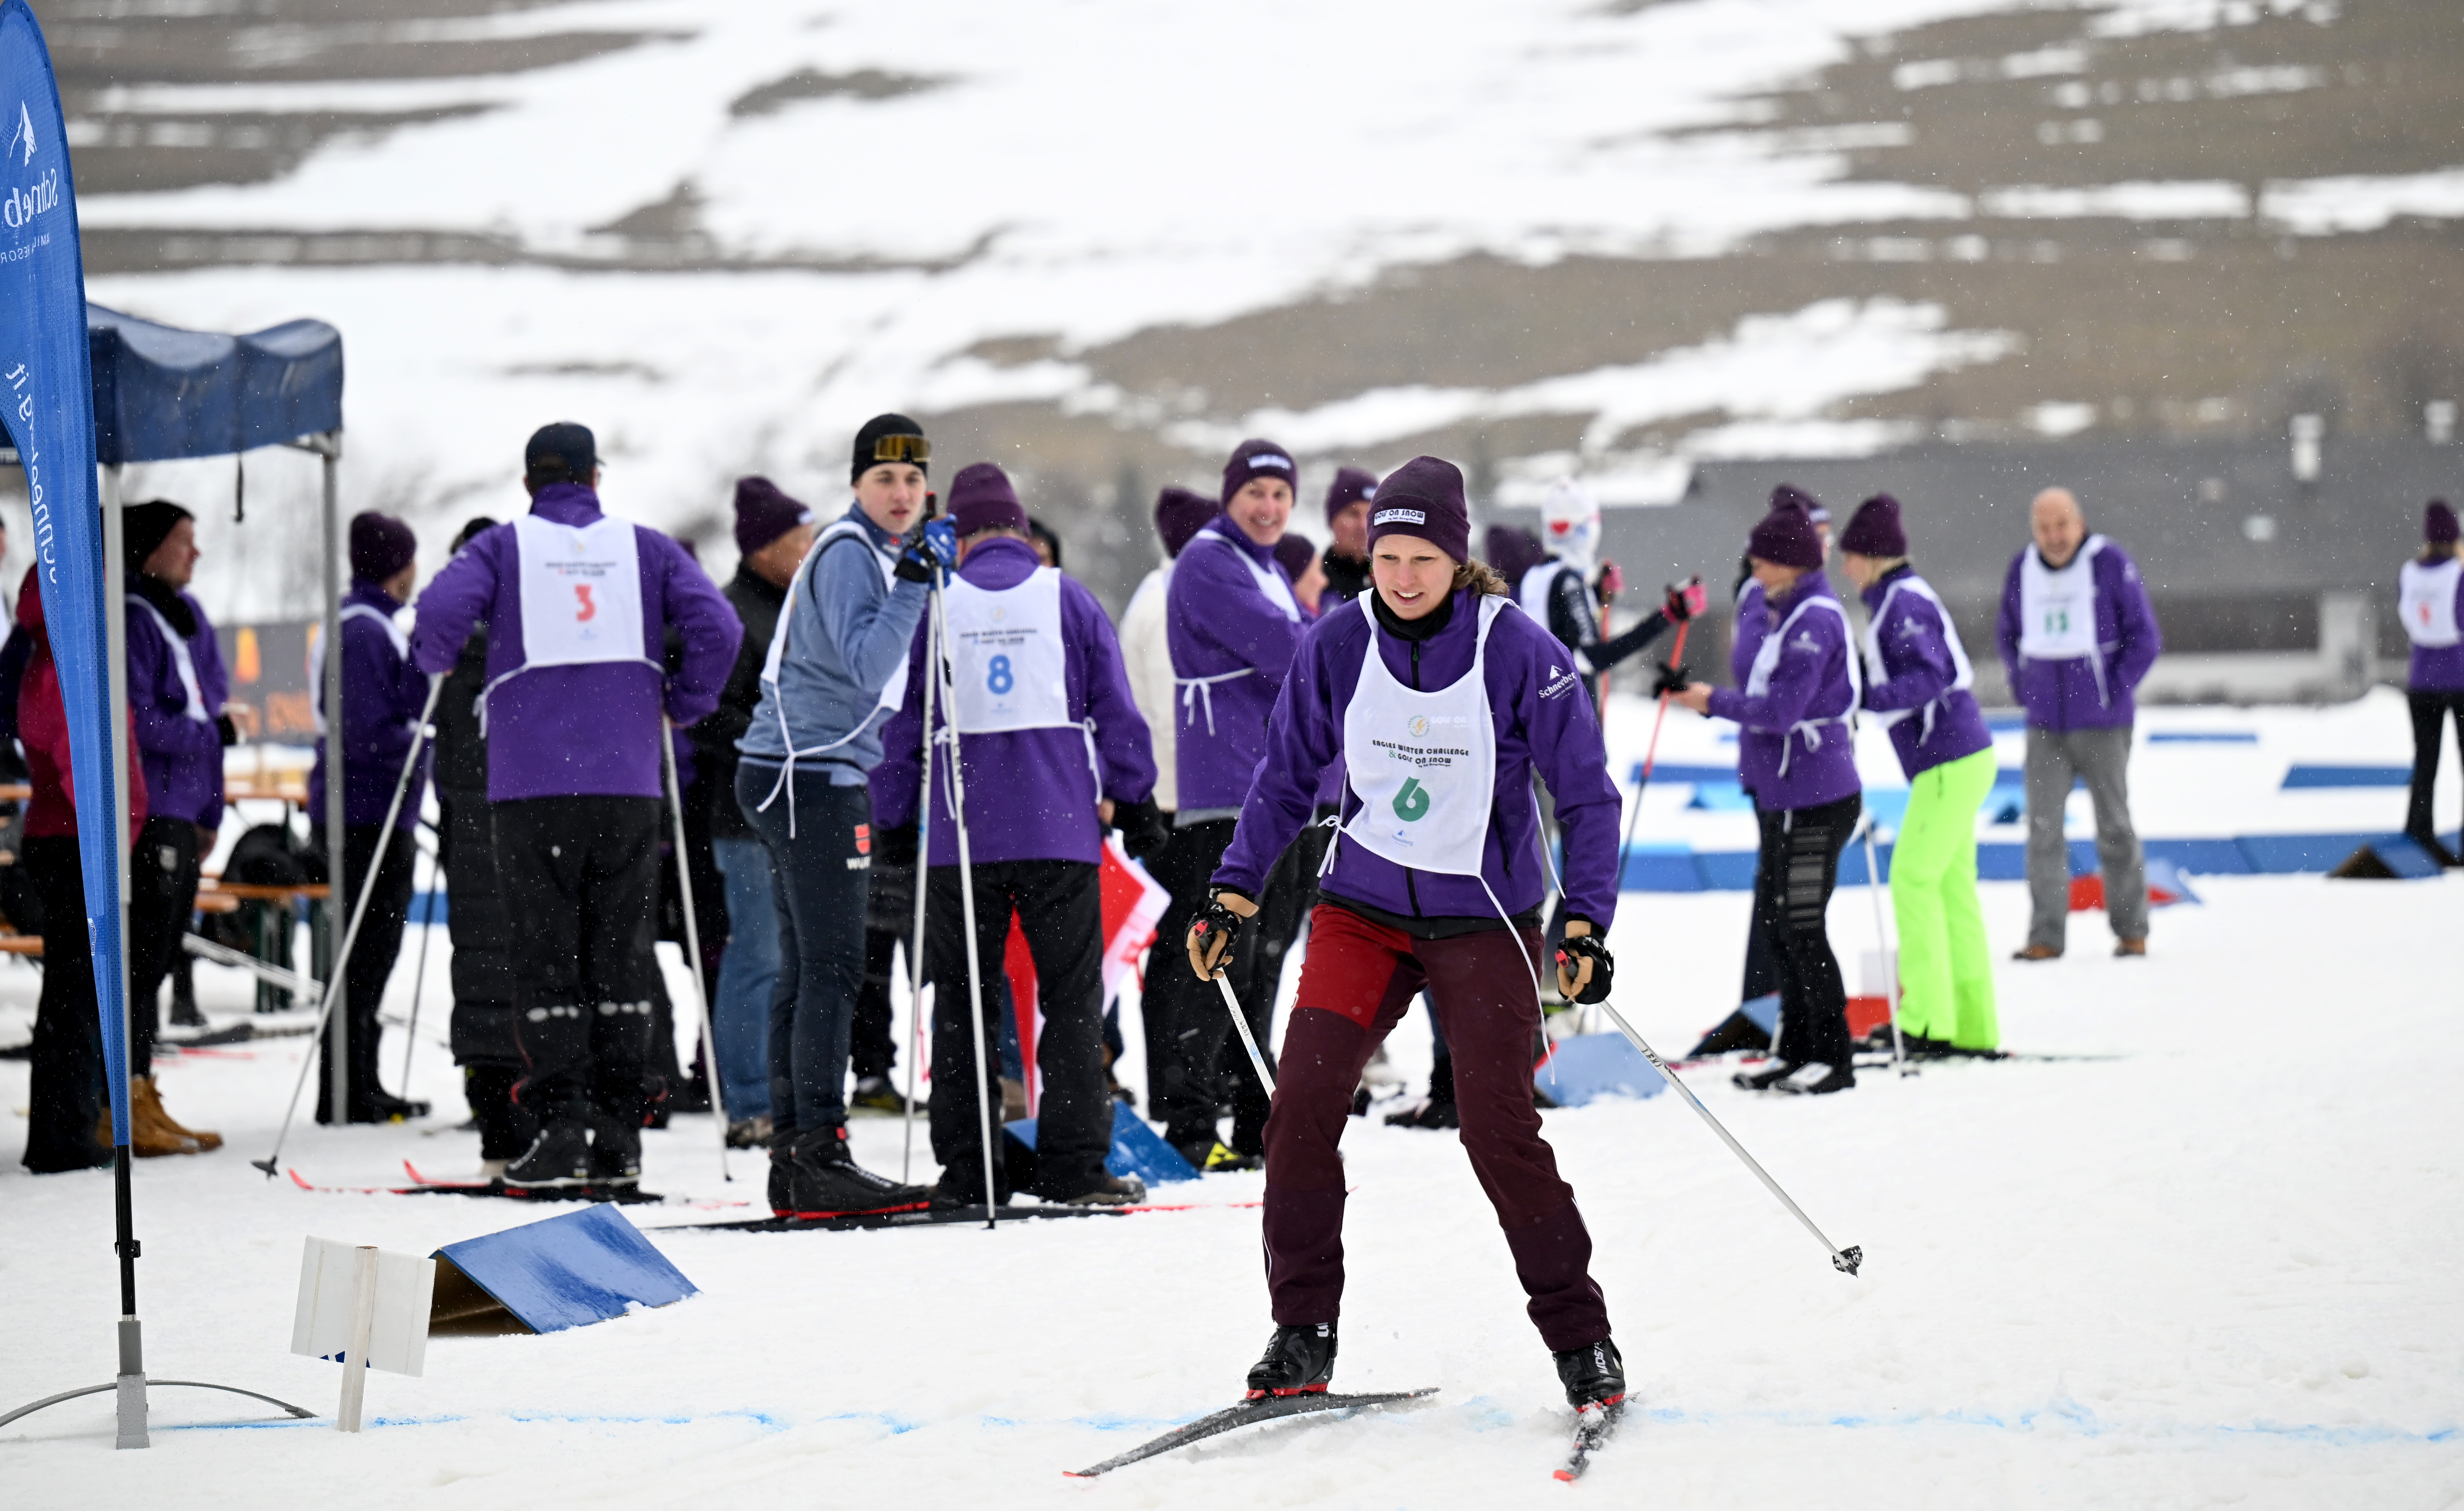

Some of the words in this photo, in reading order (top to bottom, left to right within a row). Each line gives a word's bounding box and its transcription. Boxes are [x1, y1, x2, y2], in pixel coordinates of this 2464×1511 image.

[1375, 511, 1388, 519] GOLF
[1402, 510, 1423, 518] SNOW
[575, 584, 596, 623] 3
[988, 654, 1013, 694] 8
[1372, 740, 1395, 749] EAGLES
[1398, 744, 1423, 755] WINTER
[1426, 748, 1469, 756] CHALLENGE
[1388, 749, 1396, 759] &
[1398, 753, 1413, 763] GOLF
[1392, 776, 1430, 822] 6
